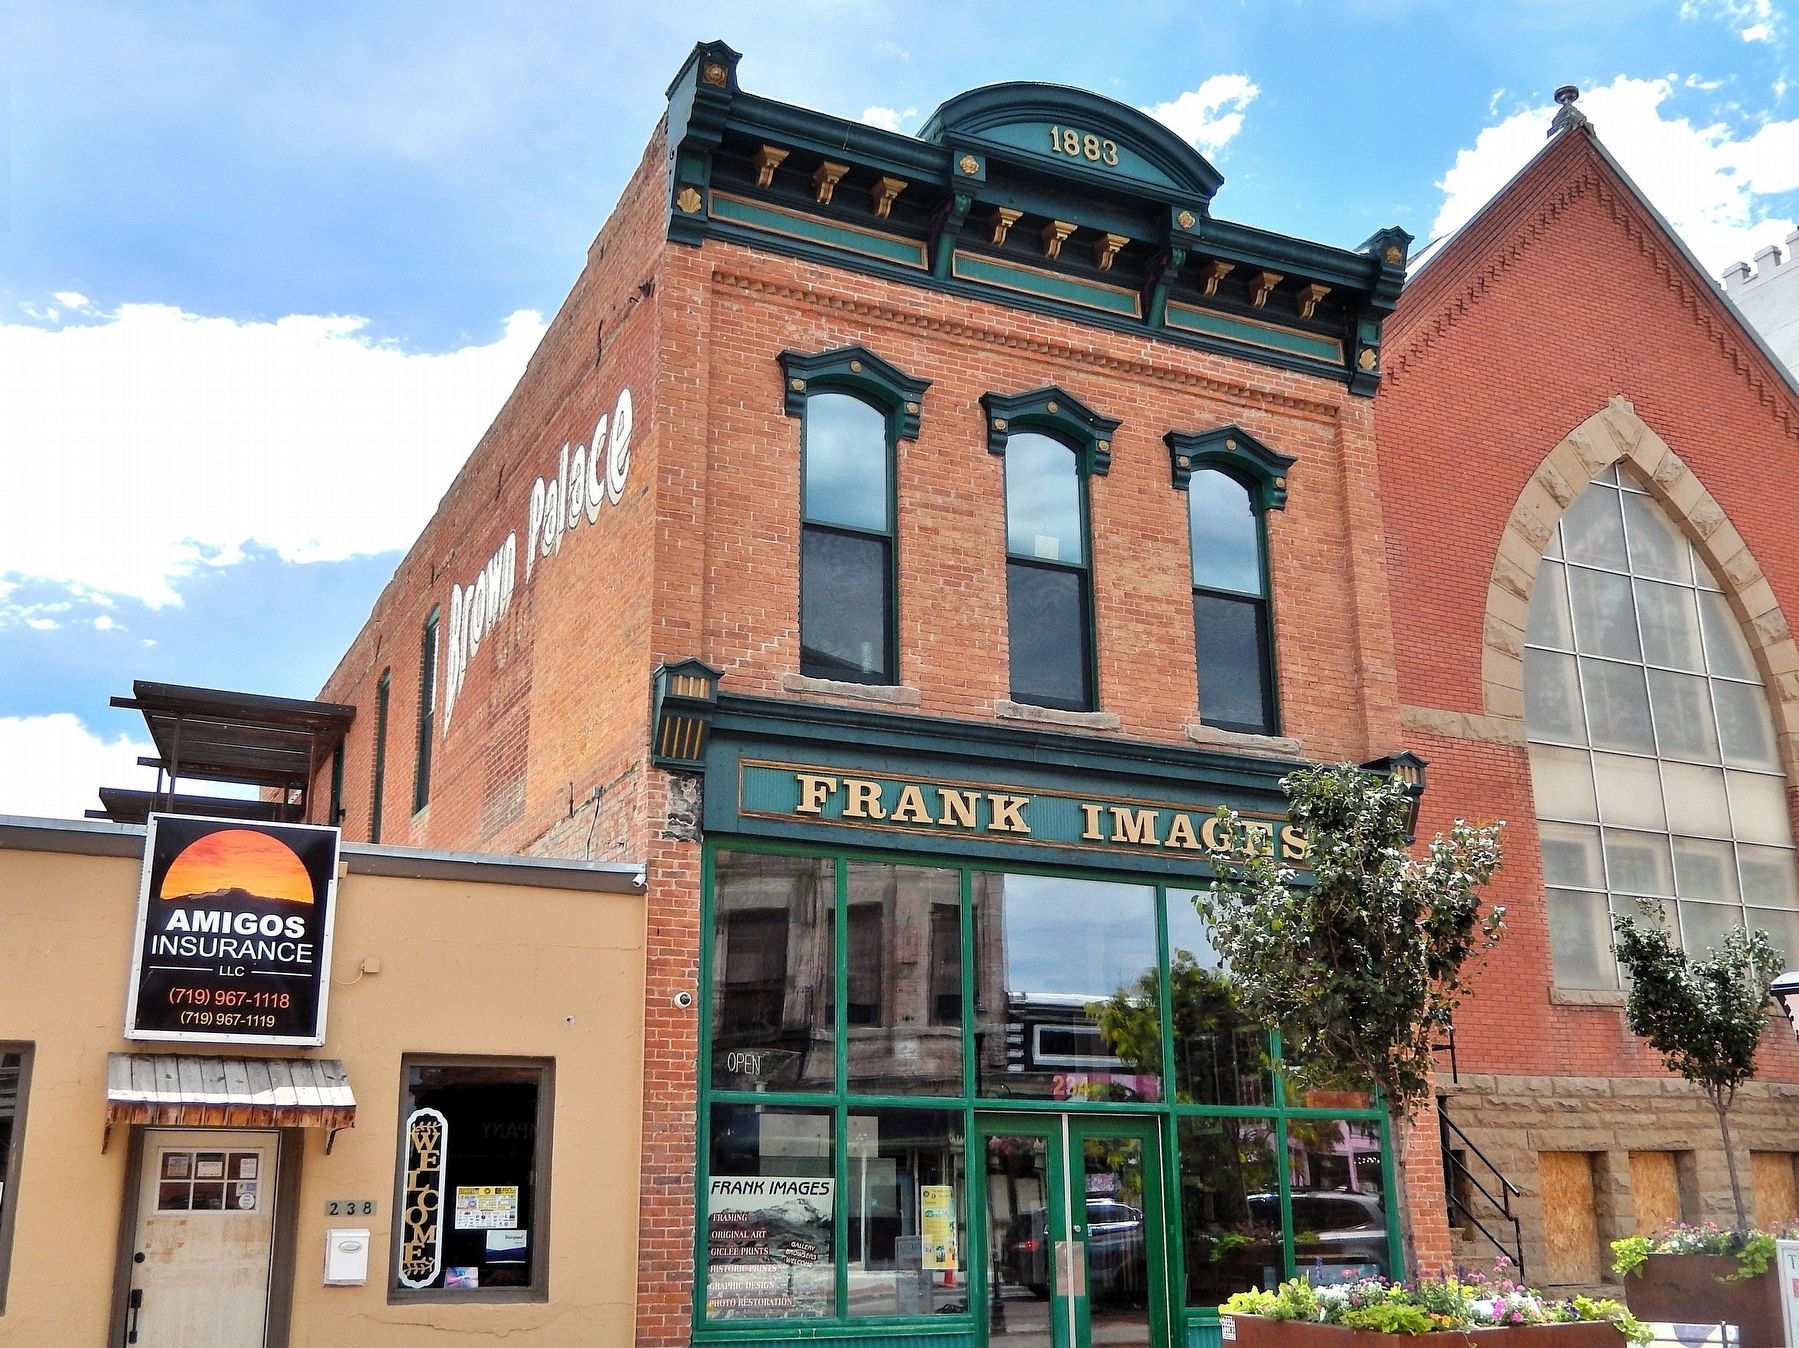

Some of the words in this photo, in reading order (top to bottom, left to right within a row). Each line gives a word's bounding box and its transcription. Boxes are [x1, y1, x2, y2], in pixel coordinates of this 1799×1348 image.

[1051, 125, 1119, 166] 1883
[443, 529, 517, 739] Brown
[525, 387, 634, 584] Palace
[796, 773, 1031, 833] FRANK
[1081, 803, 1310, 860] IMAGES
[164, 909, 306, 939] AMIGOS
[151, 935, 314, 964] INSURANCE
[219, 965, 245, 977] LLC
[169, 987, 210, 1006] (719)
[215, 990, 290, 1009] 967-1118
[181, 1011, 213, 1026] (719)
[216, 1013, 276, 1028] 967-1119
[727, 1052, 761, 1075] OPEN
[711, 1181, 765, 1195] FRANK
[769, 1181, 830, 1195] IMAGES
[404, 1131, 440, 1264] WELCOME
[329, 1201, 372, 1216] 238
[713, 1213, 748, 1222] FRAMING
[711, 1230, 749, 1239] ORIGINAL
[751, 1230, 767, 1238] ART
[740, 1247, 769, 1256] PRINTS
[790, 1241, 816, 1251] GALLERY
[710, 1264, 748, 1273] HISTORIC
[749, 1264, 777, 1272] PRINTS
[709, 1281, 744, 1290] GRAPHIC
[745, 1281, 775, 1289] DESIGN
[709, 1298, 736, 1307] PHOTO
[738, 1297, 793, 1307] RESTORATION
